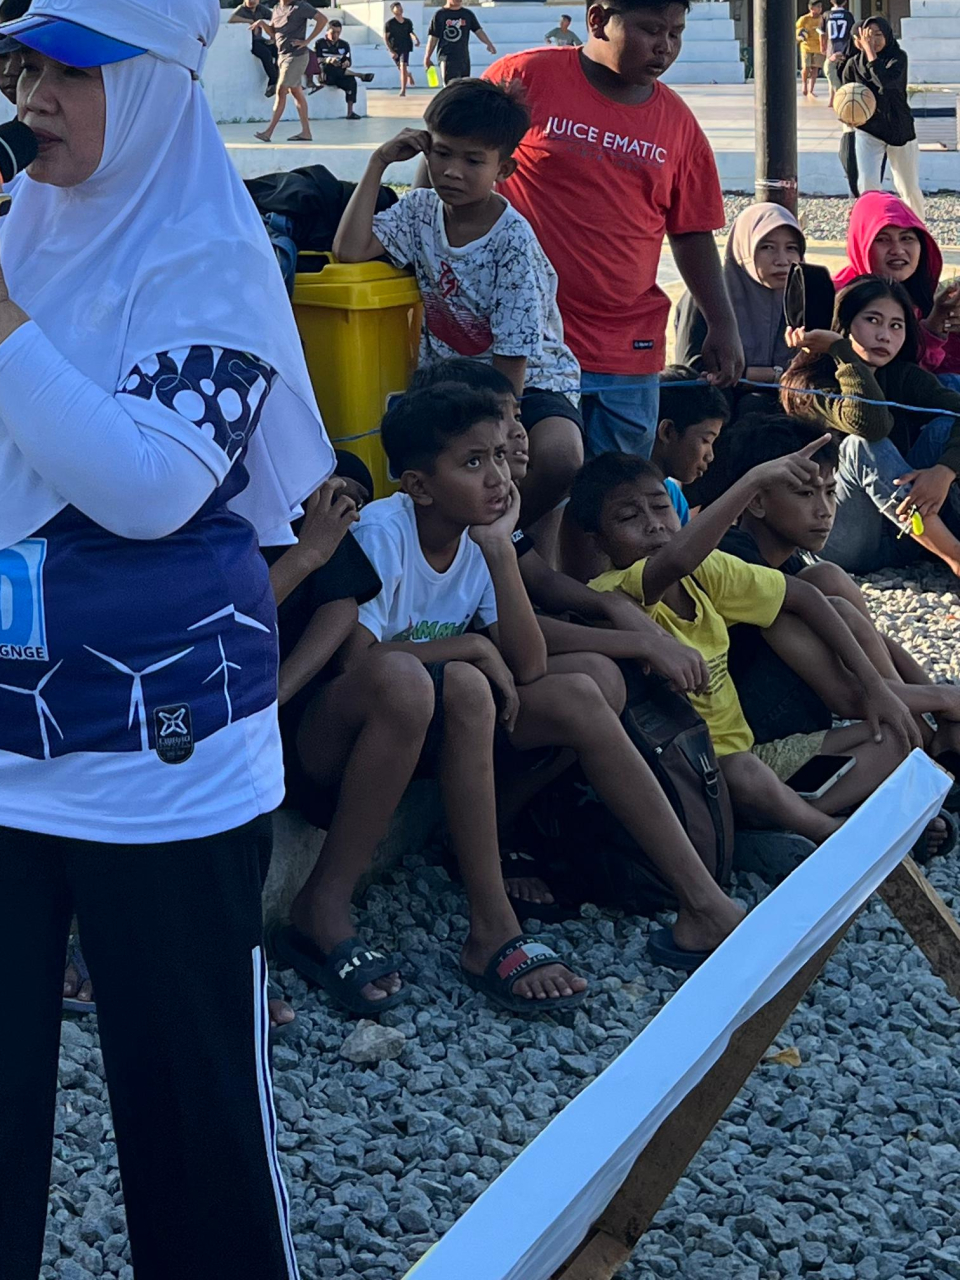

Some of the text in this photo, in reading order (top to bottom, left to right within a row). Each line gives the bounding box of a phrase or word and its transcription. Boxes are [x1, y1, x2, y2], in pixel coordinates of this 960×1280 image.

[828, 20, 847, 39] 07
[543, 116, 599, 142] JUICE
[603, 131, 667, 163] EMATIC
